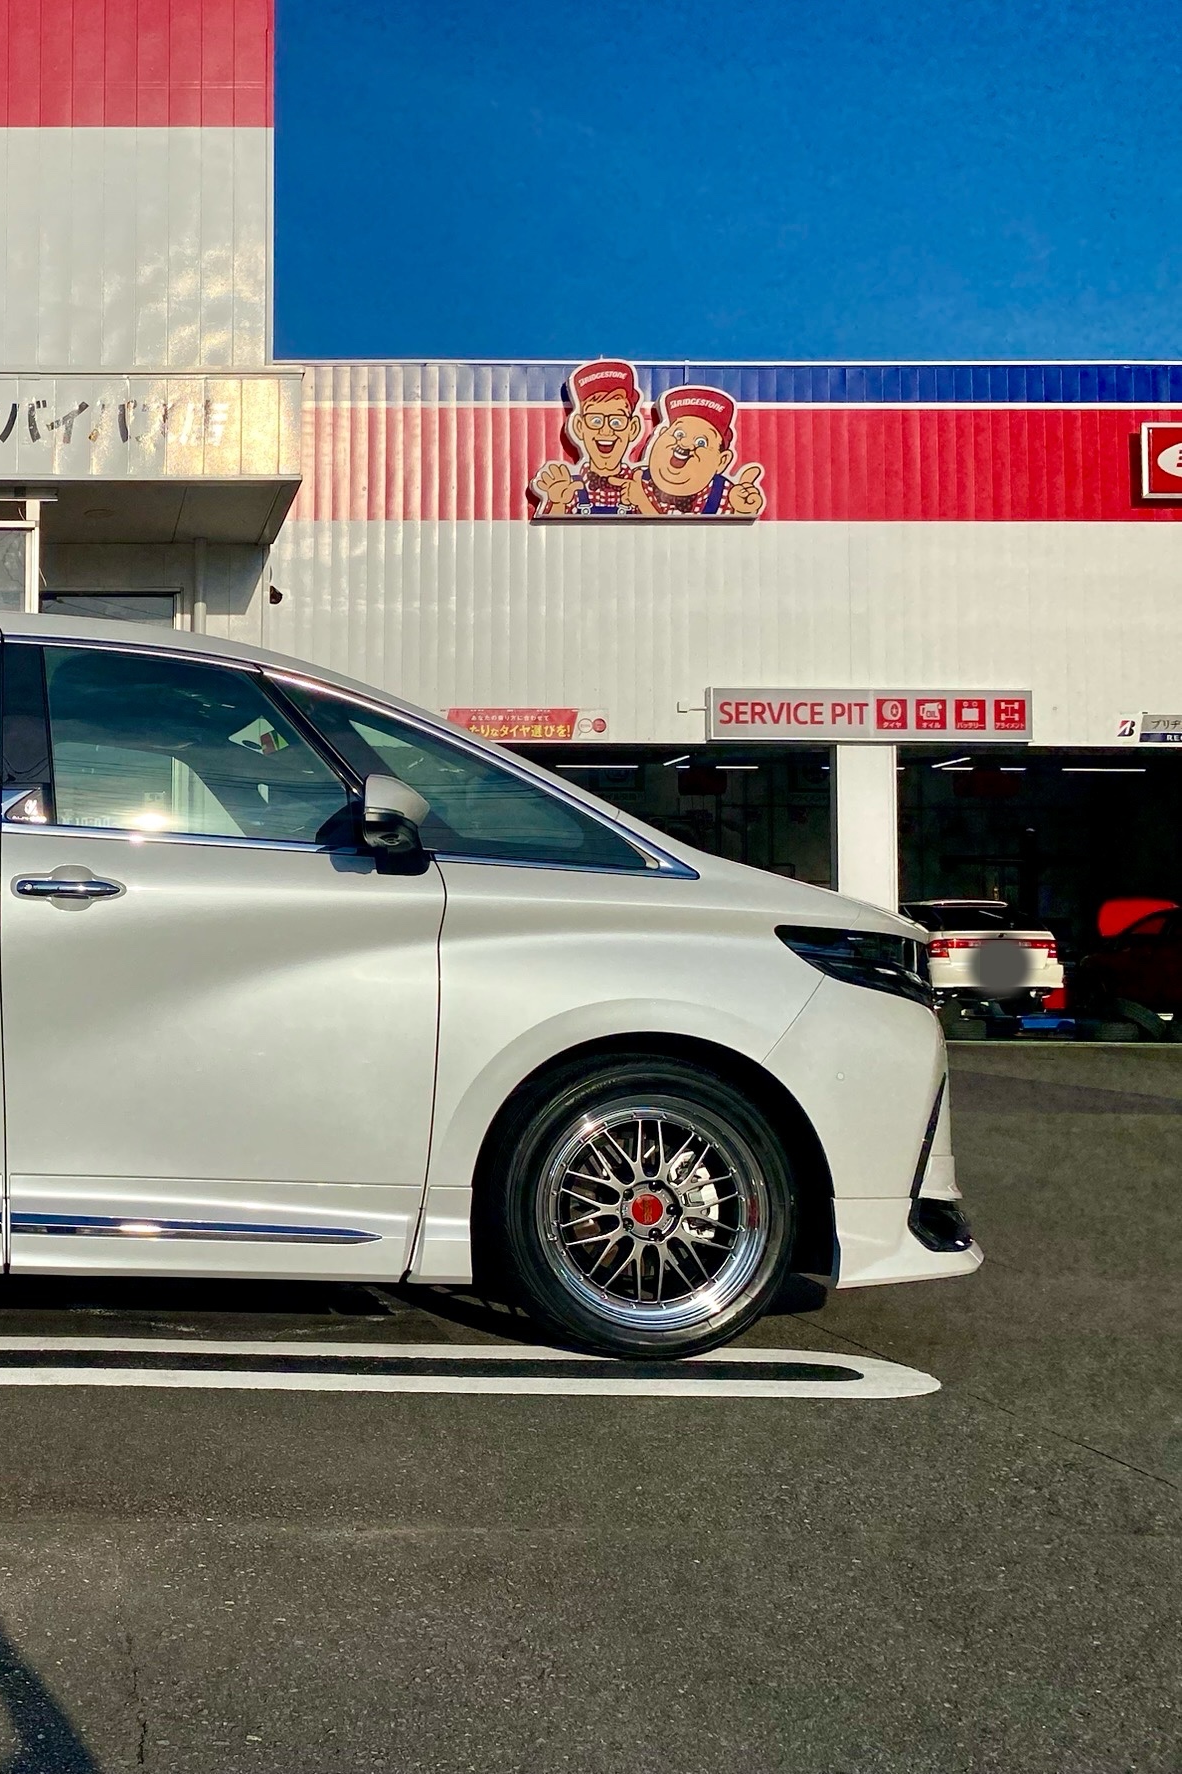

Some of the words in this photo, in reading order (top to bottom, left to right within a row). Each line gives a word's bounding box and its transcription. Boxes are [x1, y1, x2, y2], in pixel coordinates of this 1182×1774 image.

[578, 371, 627, 387] BRIDGESTONE
[669, 398, 726, 412] BRIDGESTONE
[718, 701, 824, 725] SERVICE
[831, 702, 869, 725] PIT
[926, 710, 938, 718] OIL
[956, 722, 986, 730] バッテリー
[995, 722, 1025, 730] アライメント
[1166, 734, 1182, 742] RE
